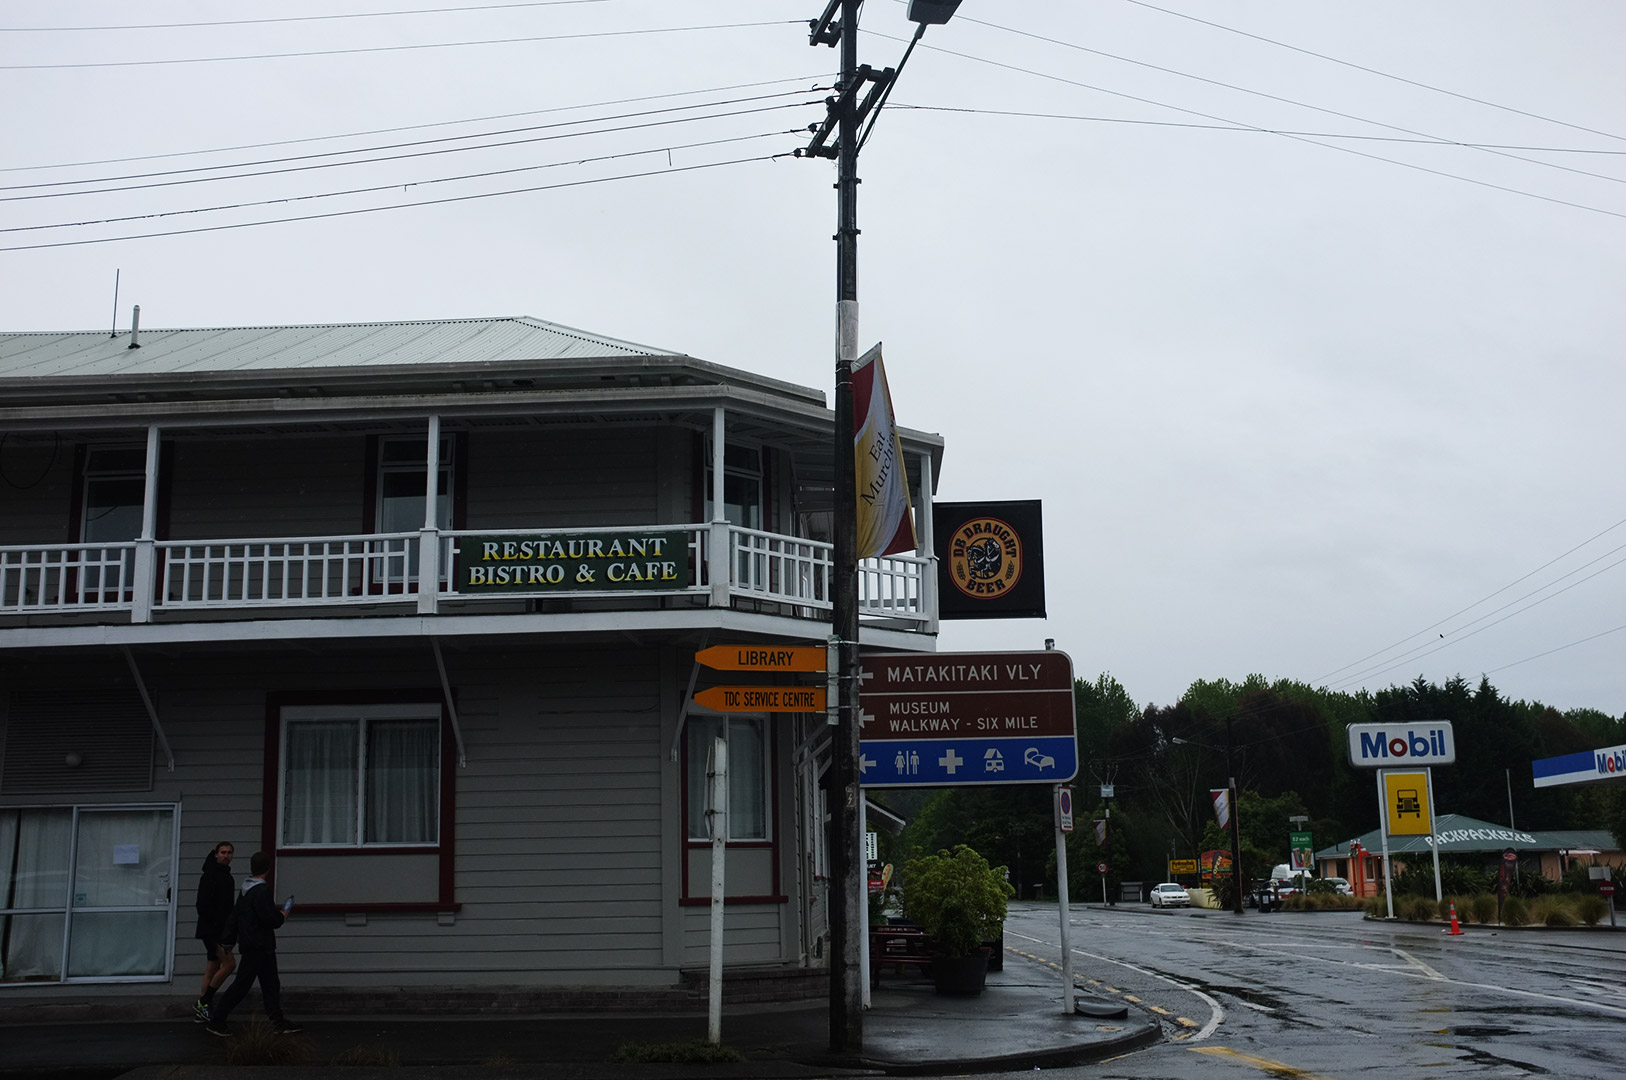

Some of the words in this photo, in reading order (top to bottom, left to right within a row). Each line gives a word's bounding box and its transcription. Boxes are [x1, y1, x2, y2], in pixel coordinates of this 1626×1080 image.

[868, 431, 886, 463] Eat
[953, 538, 967, 557] DB
[963, 522, 1017, 558] DRAUGHT
[482, 538, 668, 562] RESTAURANT
[468, 564, 565, 586] BISTRO
[575, 563, 597, 583] &
[606, 561, 679, 582] CAFE
[965, 579, 1006, 594] BEER
[738, 650, 794, 666] LIBRARY
[887, 665, 998, 683] MATAKITAKI
[1006, 664, 1042, 681] VLY
[724, 691, 740, 706] TDC
[743, 692, 778, 707] SERVICE
[782, 692, 815, 707] CENTRE
[889, 701, 950, 715] MUSEUM
[889, 718, 960, 732] WALKWAY
[977, 717, 999, 730] SIX
[1005, 716, 1038, 729] MILE
[1360, 729, 1446, 758] Mobil
[1424, 828, 1537, 847] BACKPACKERS
